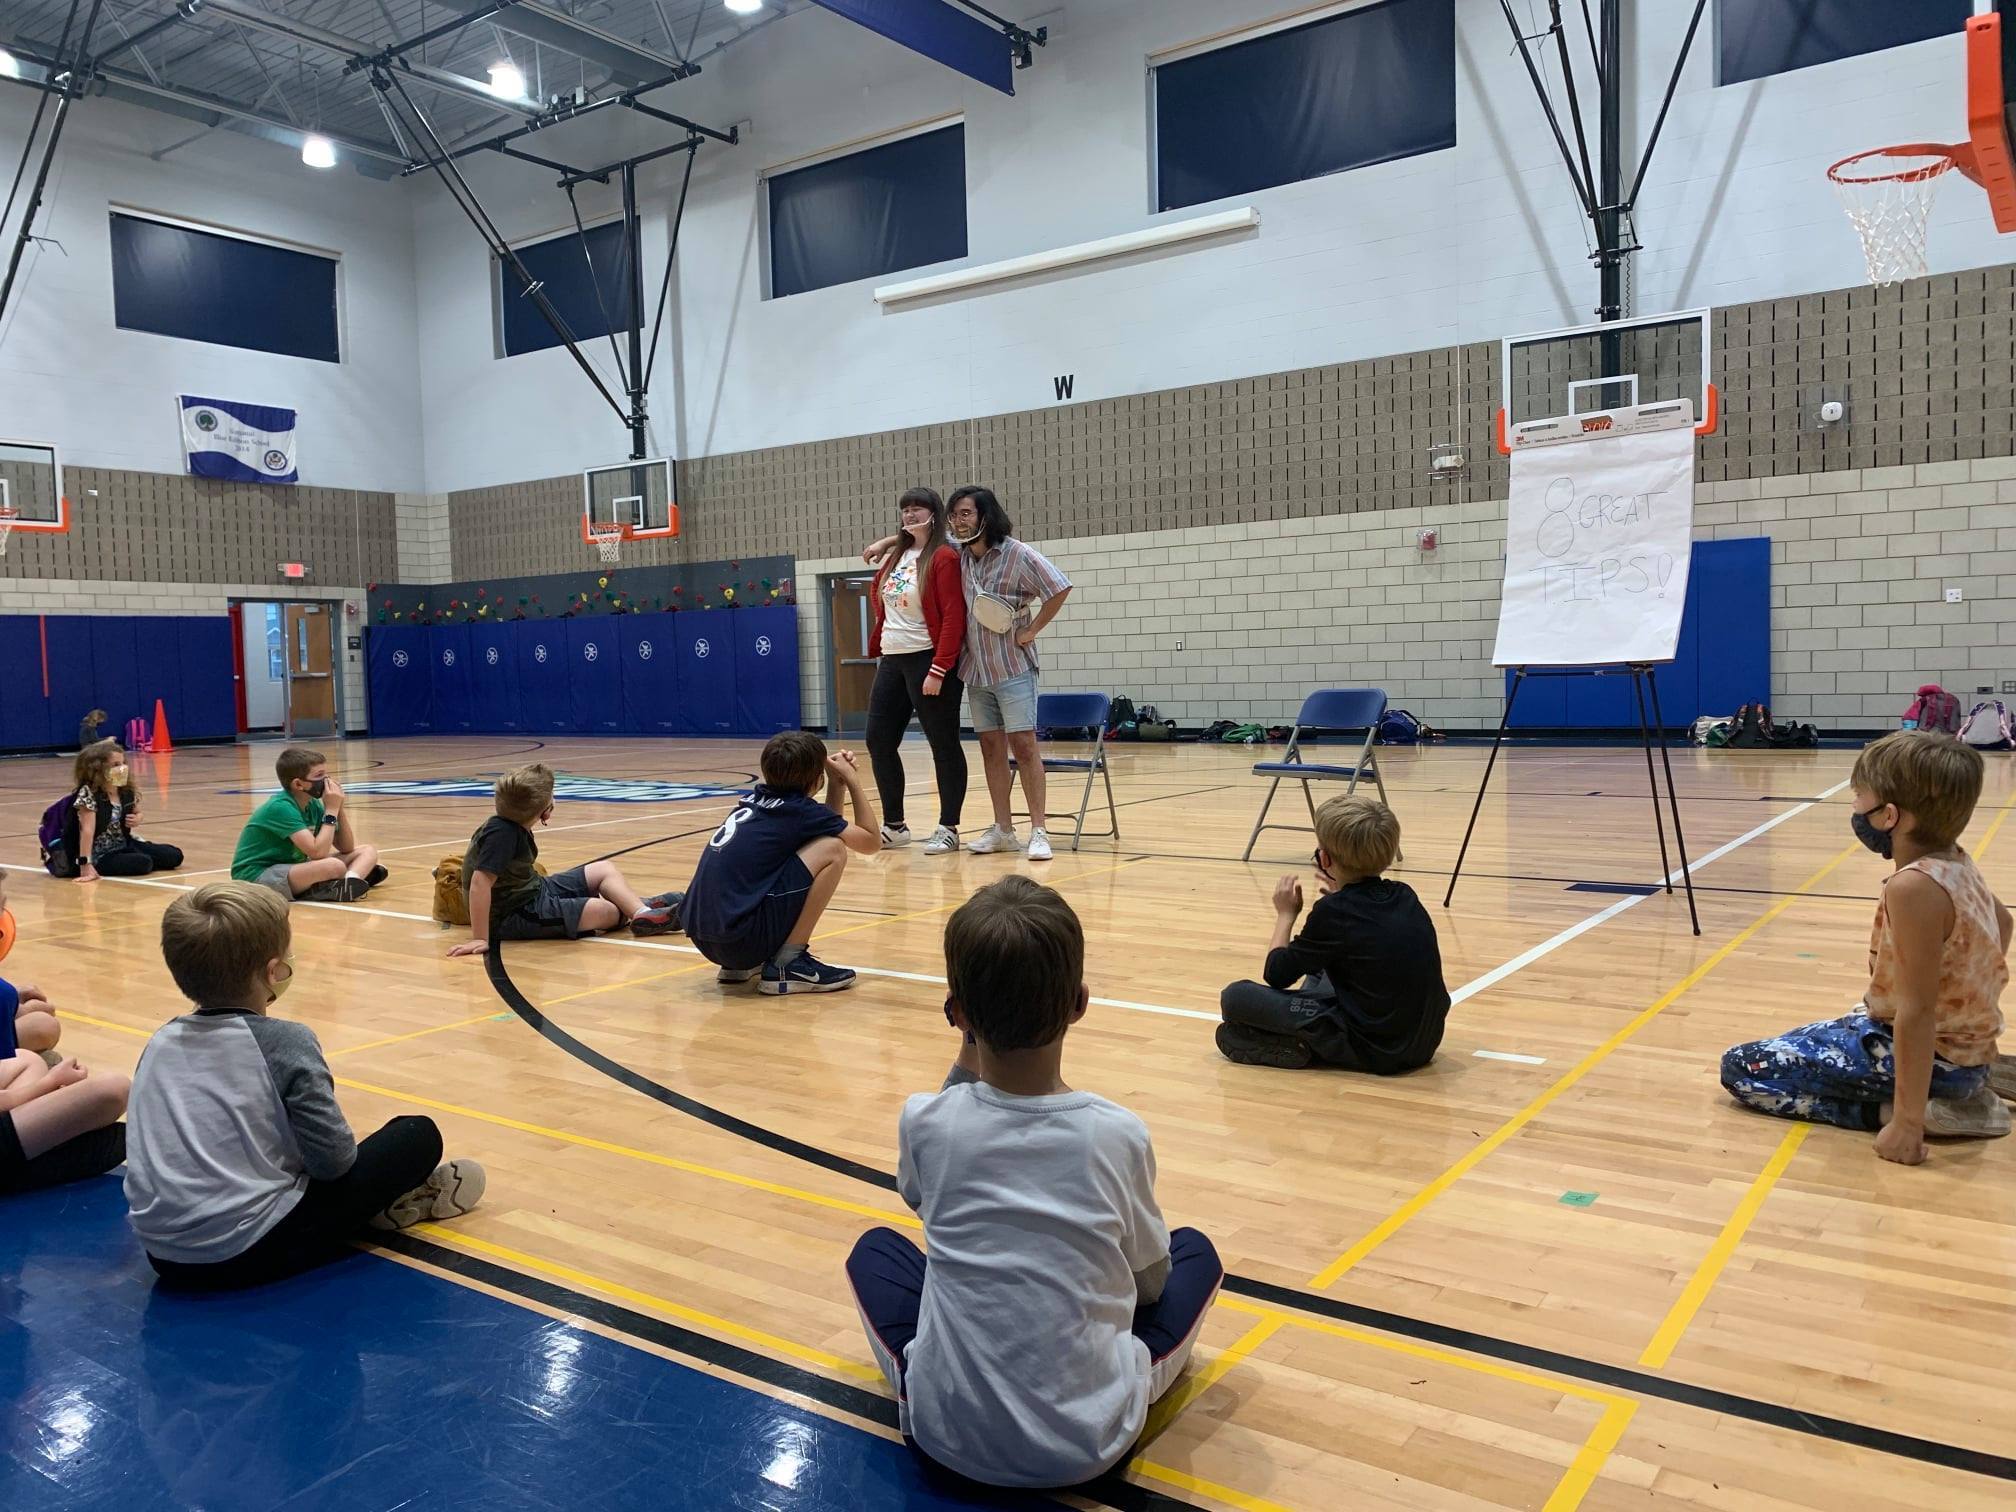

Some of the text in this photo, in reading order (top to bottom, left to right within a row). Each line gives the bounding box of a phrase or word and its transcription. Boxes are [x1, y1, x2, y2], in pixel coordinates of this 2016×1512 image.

[1053, 374, 1074, 401] W
[1537, 477, 1669, 558] 8 GREAT
[1528, 552, 1673, 604] TIPS!
[709, 807, 753, 848] 8
